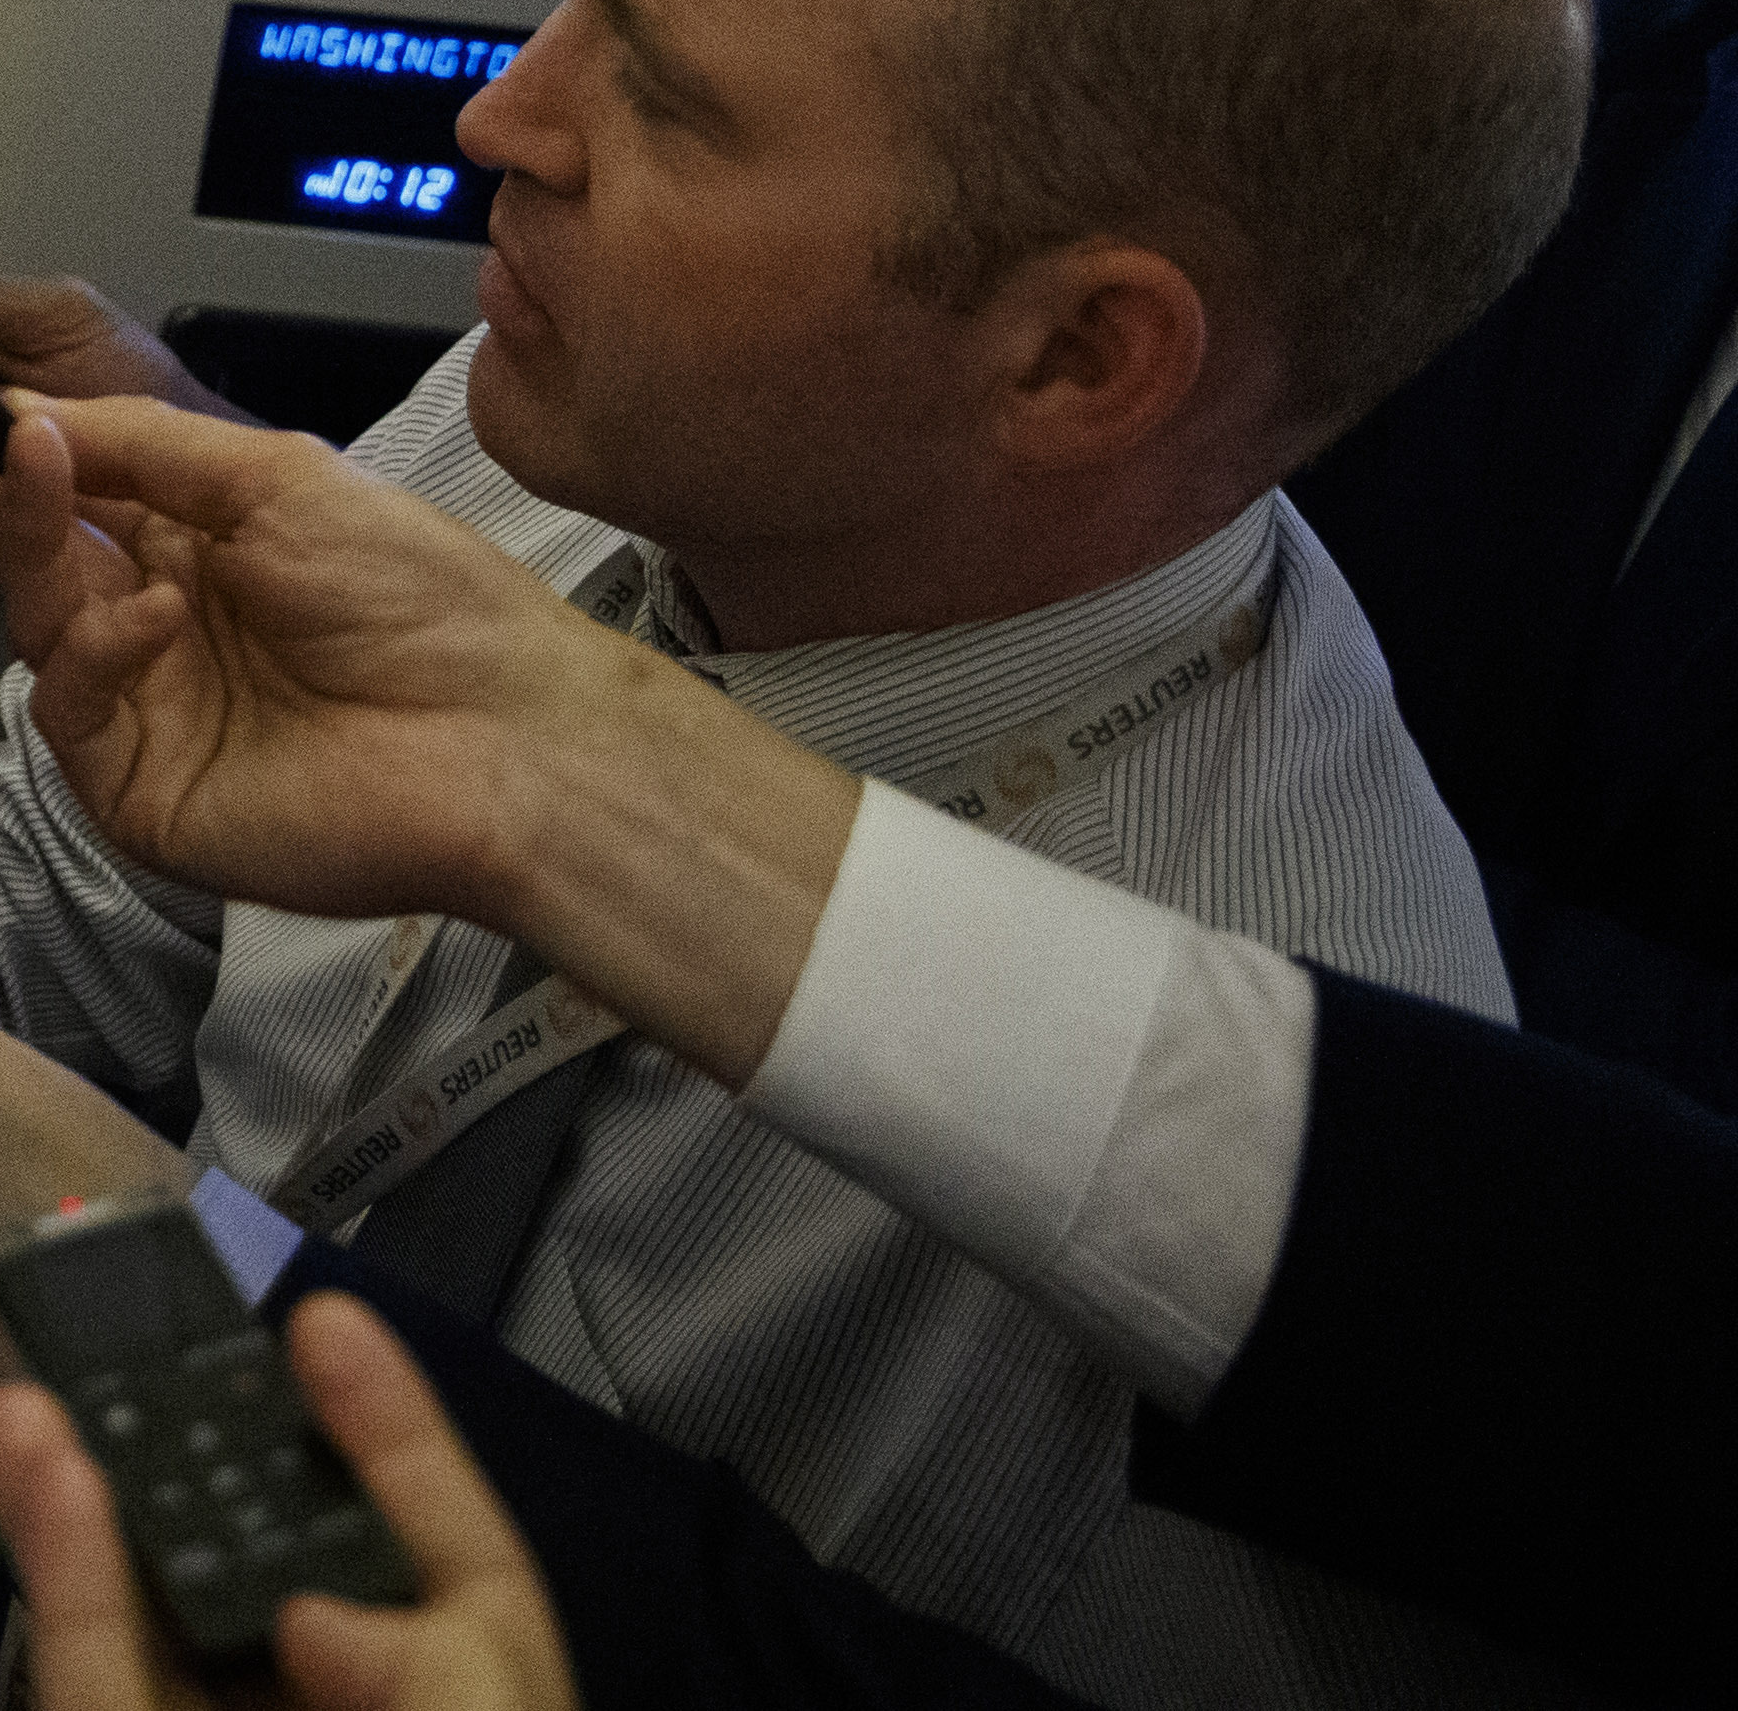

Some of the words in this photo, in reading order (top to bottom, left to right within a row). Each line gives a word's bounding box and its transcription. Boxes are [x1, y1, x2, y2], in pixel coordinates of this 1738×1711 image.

[1067, 650, 1212, 761] REUTERS
[439, 1018, 542, 1107] REUTERS
[310, 1124, 403, 1203] REUTERS
